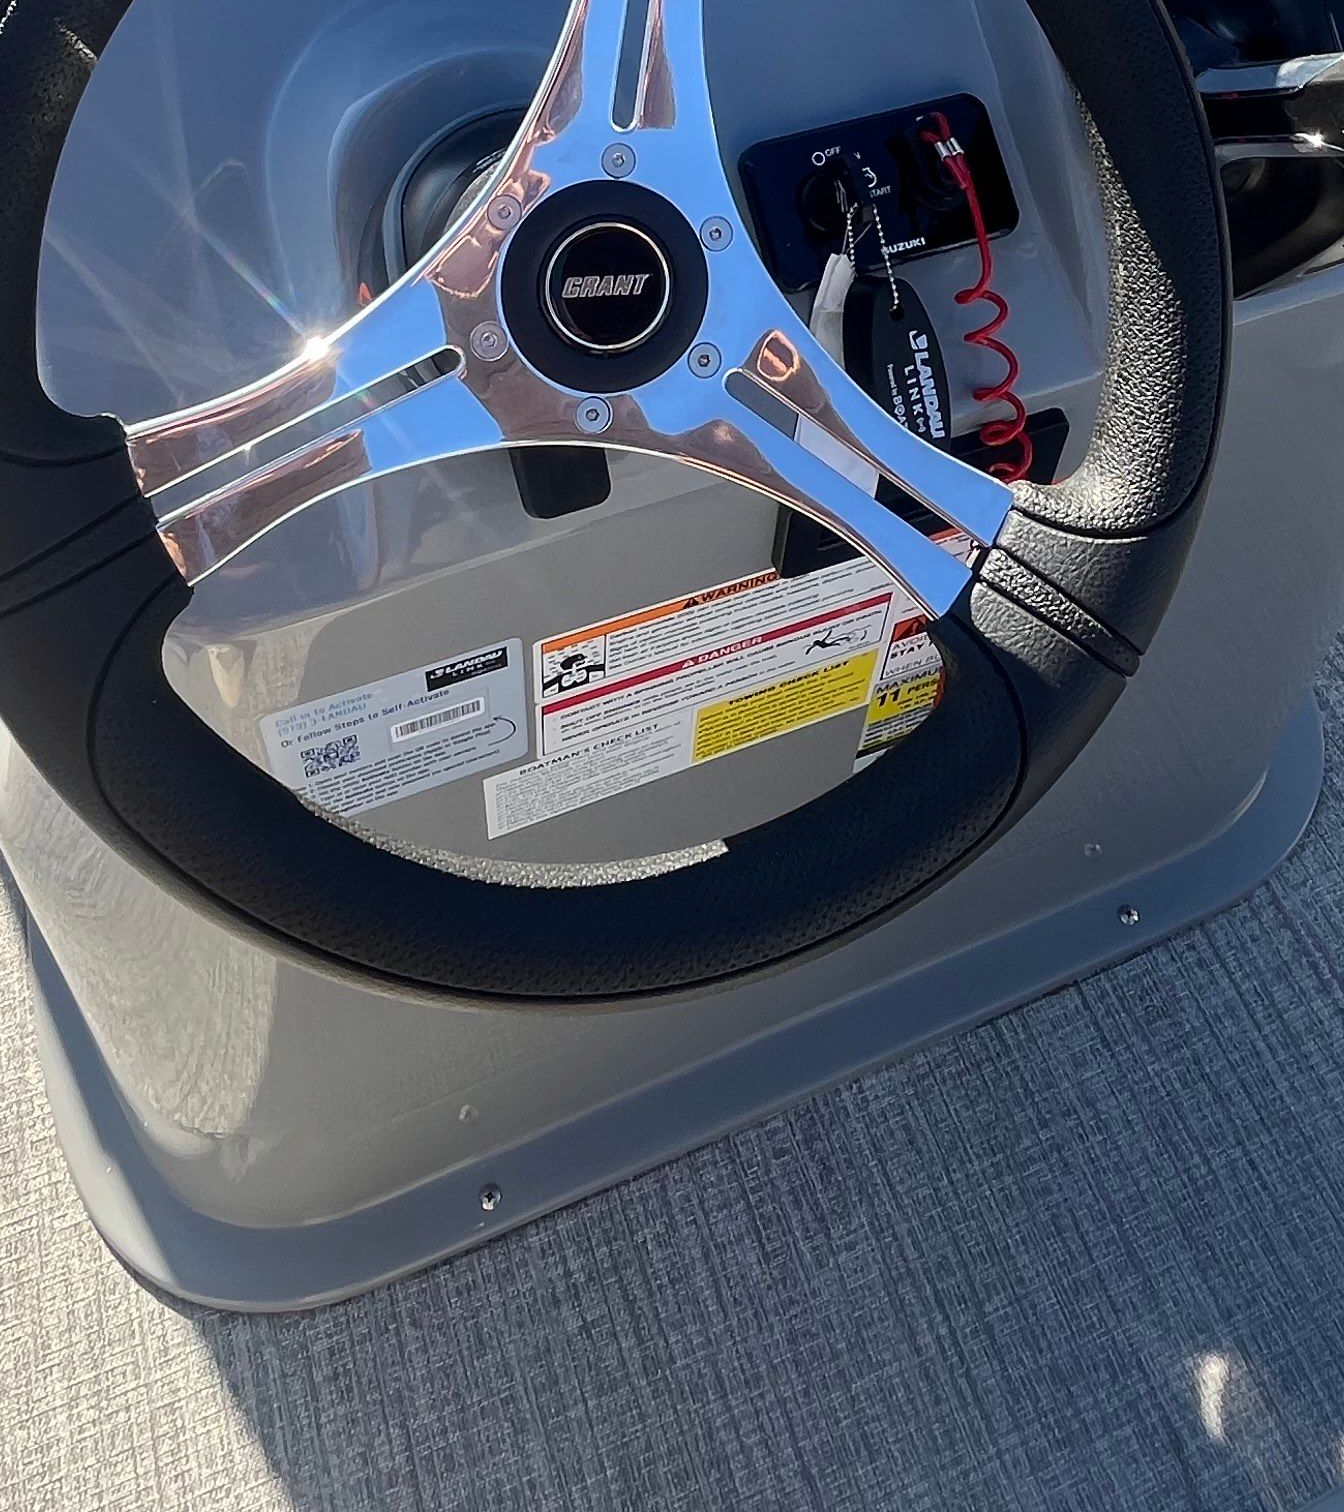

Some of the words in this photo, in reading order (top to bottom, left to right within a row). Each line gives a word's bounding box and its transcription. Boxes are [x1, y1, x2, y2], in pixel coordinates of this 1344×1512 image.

[562, 274, 650, 298] GRANT
[904, 364, 924, 416] LINK
[914, 351, 946, 439] LANDAU
[702, 572, 780, 603] WARNING
[445, 650, 503, 673] LANDAU
[697, 636, 763, 663] DANGER
[890, 642, 926, 659] STAY
[334, 716, 366, 733] Steps
[381, 689, 450, 717] Self-Activate
[876, 688, 901, 707] 11
